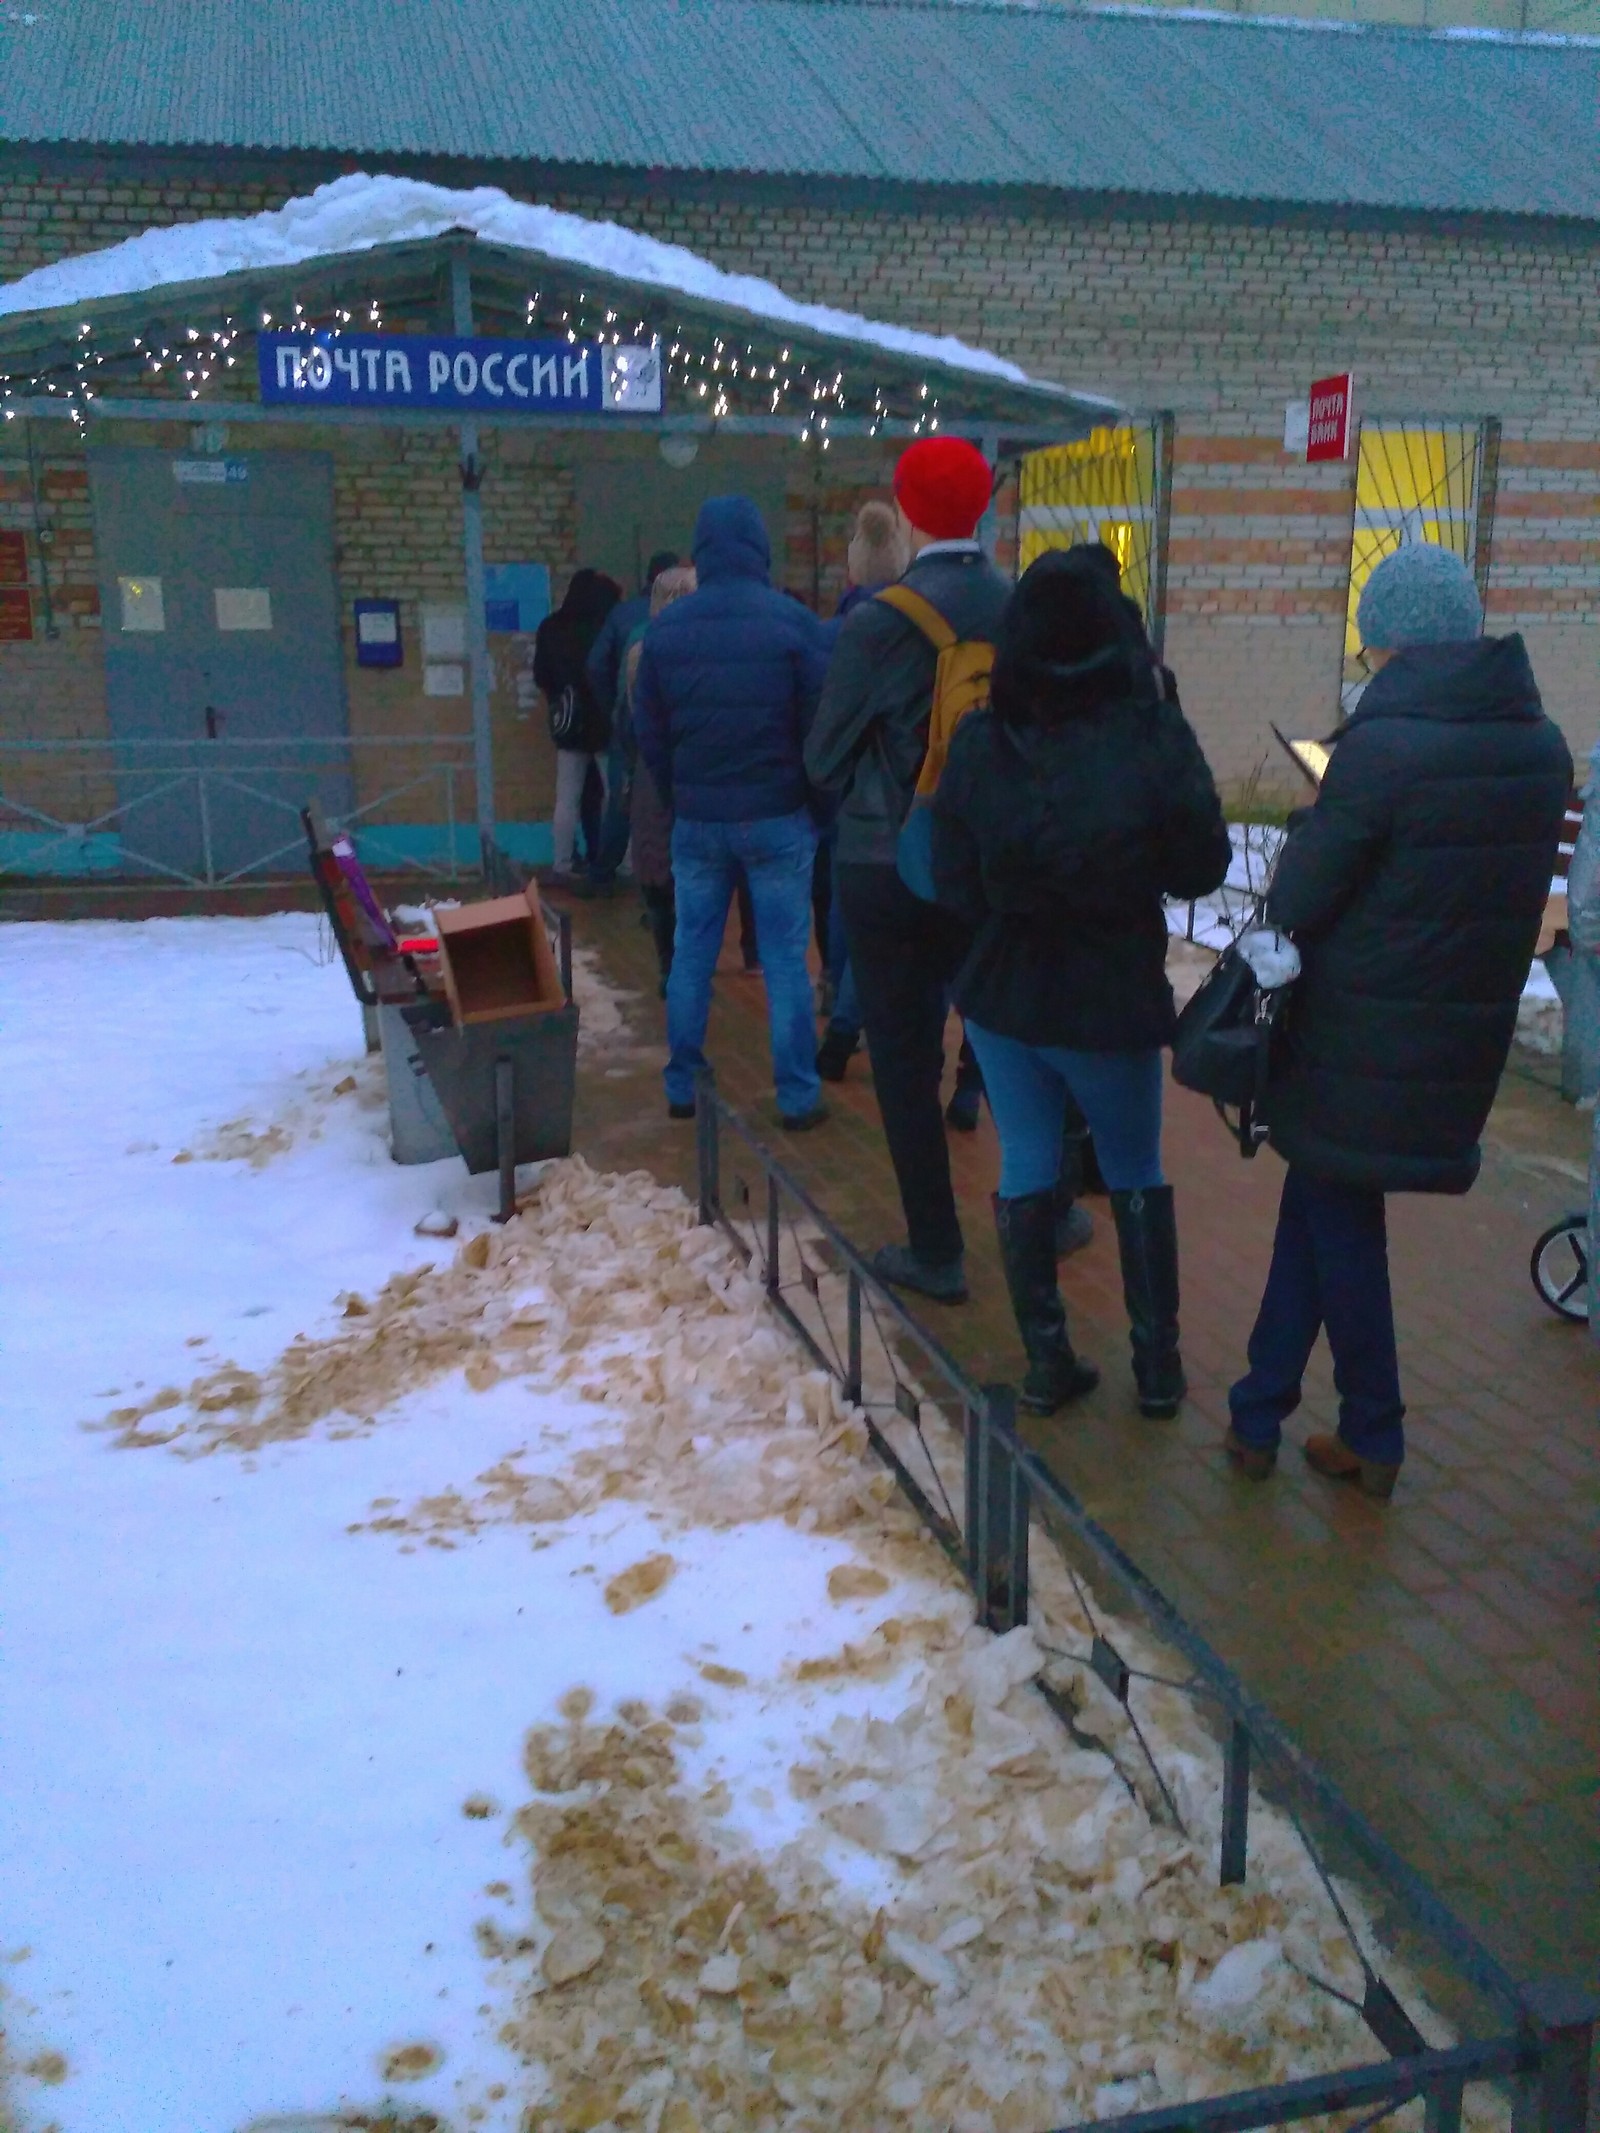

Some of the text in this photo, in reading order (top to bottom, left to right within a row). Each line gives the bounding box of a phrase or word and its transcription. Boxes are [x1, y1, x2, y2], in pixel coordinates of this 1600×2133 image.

[275, 345, 589, 398] ПОЧТА РОССИИ
[1312, 393, 1344, 421] ПОЧТА
